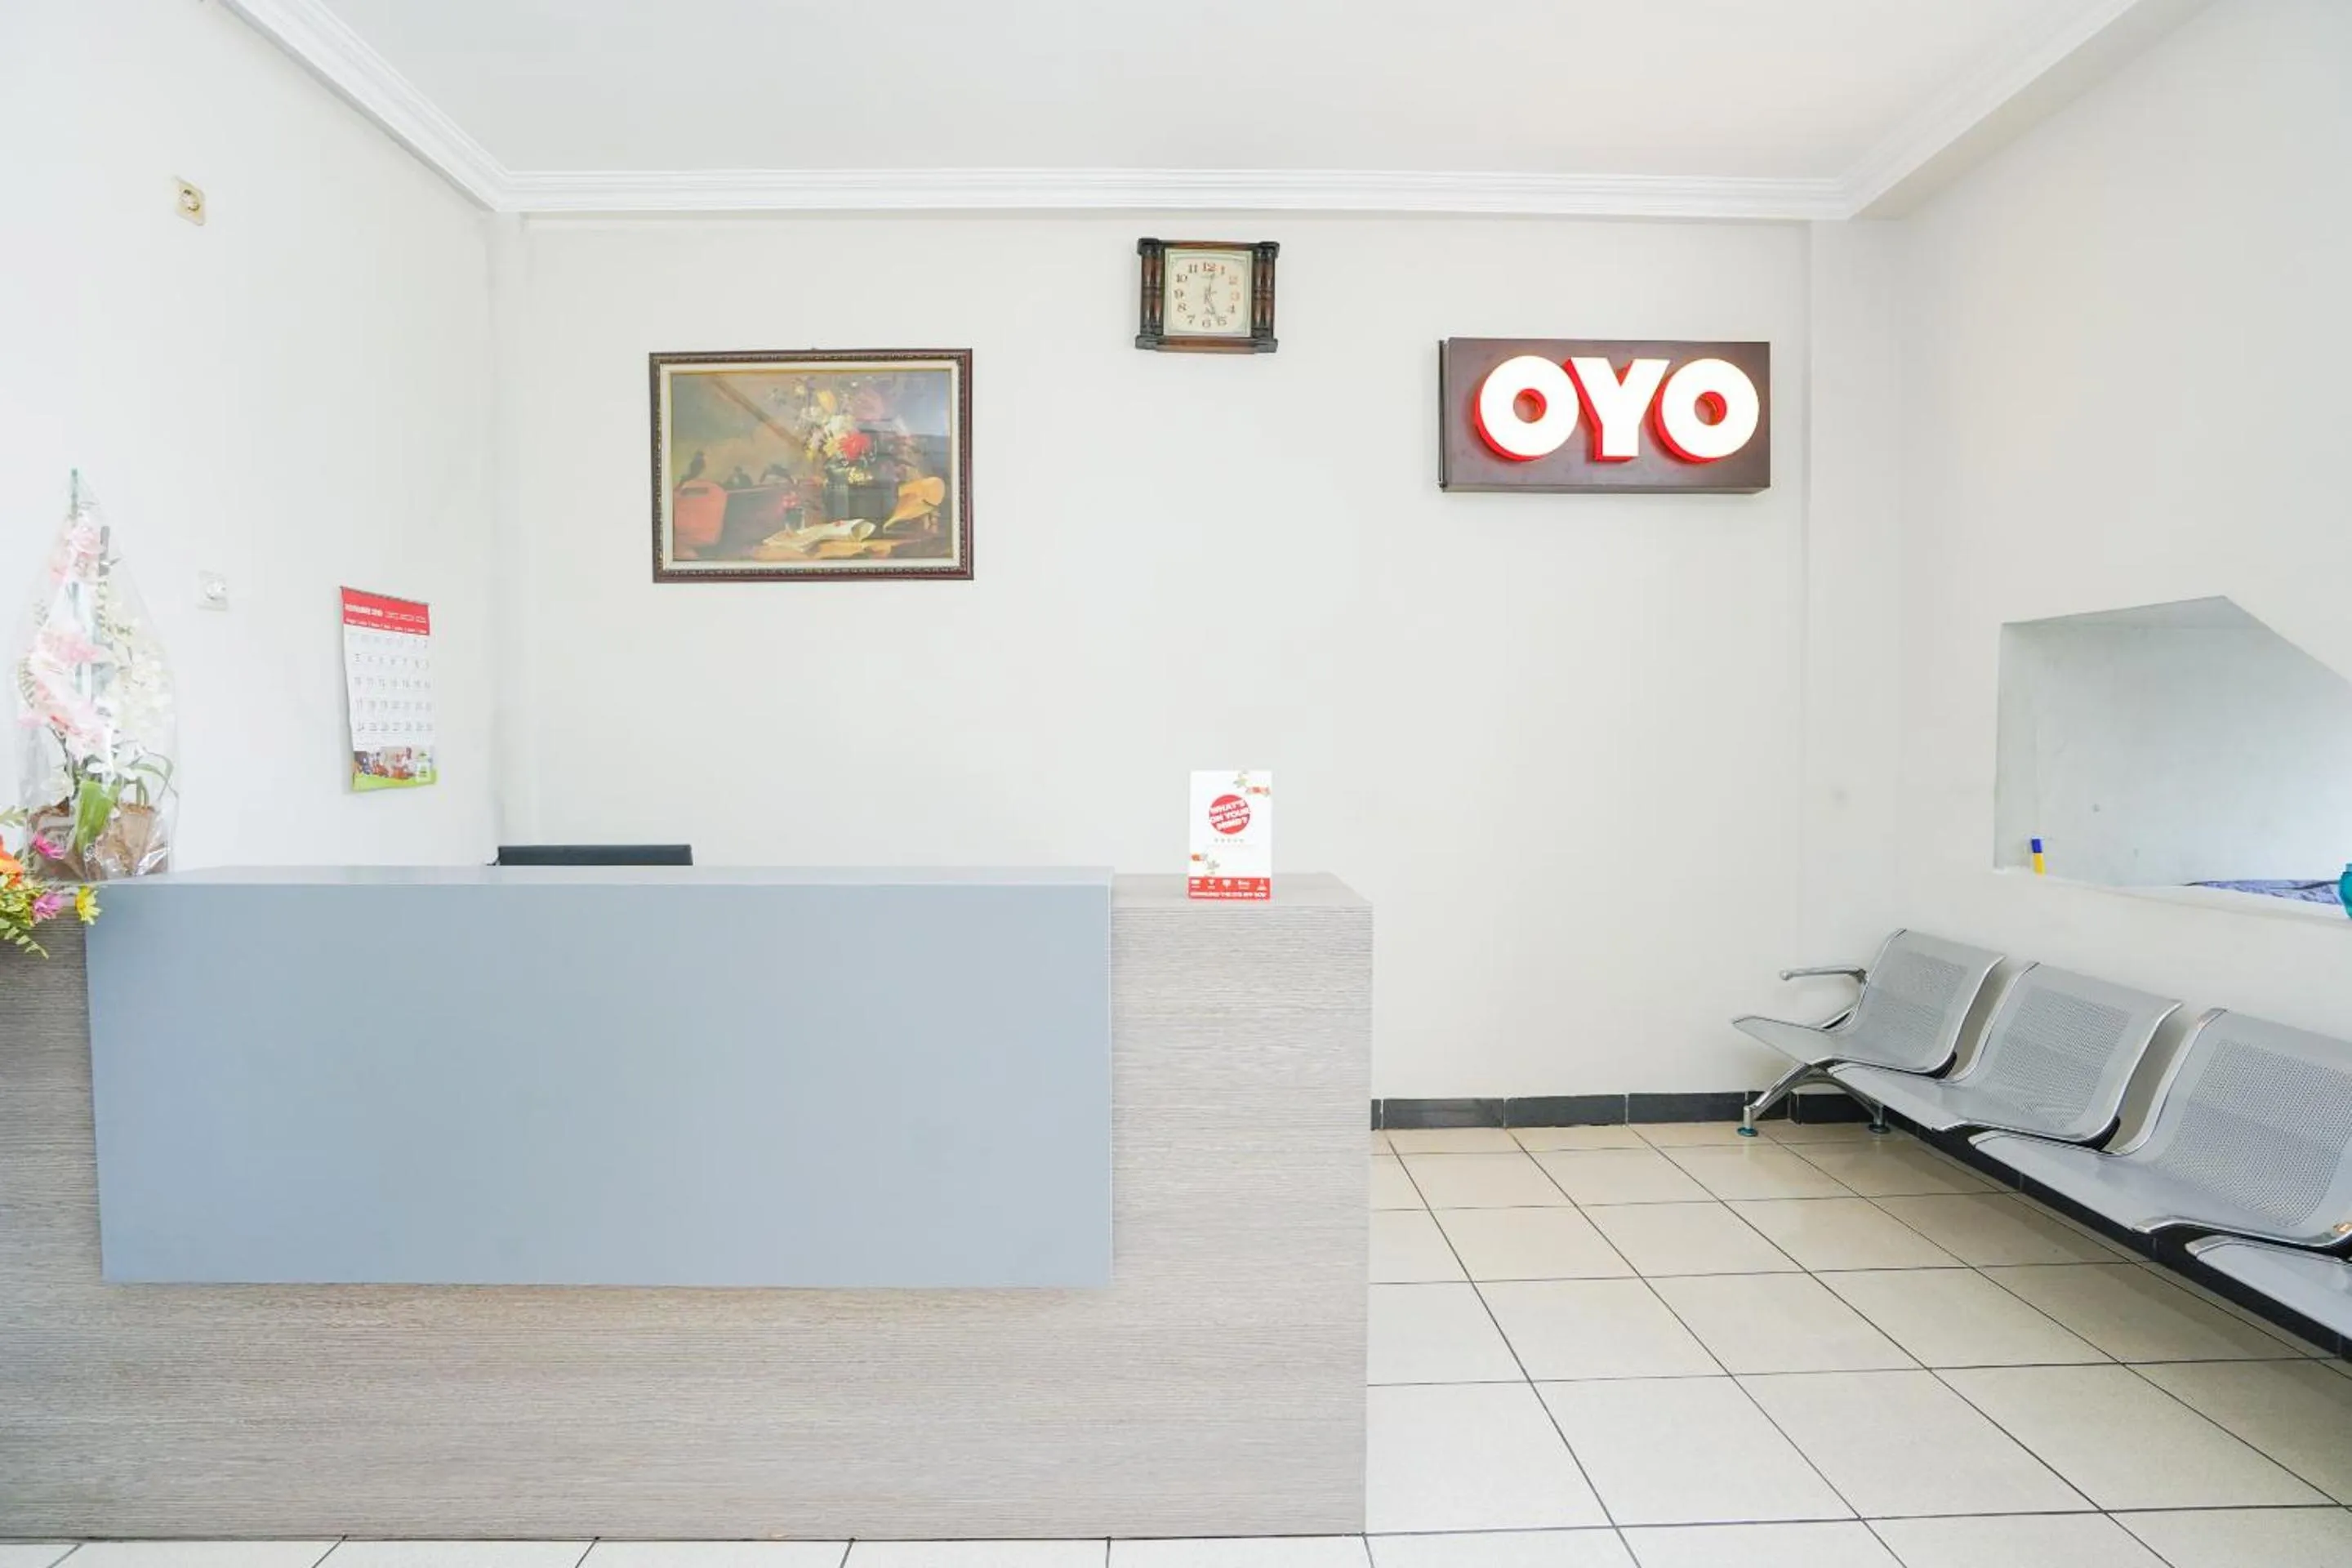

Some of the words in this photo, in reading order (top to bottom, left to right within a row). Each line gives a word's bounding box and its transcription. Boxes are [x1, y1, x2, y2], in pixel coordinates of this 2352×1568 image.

[1188, 264, 1198, 274] 11
[1203, 262, 1216, 272] 12
[1176, 274, 1187, 283] 10
[1174, 290, 1184, 299] 9
[1177, 303, 1187, 313] 8
[1227, 305, 1236, 314] 4
[1187, 315, 1196, 324] 7
[1475, 355, 1759, 462] OYO
